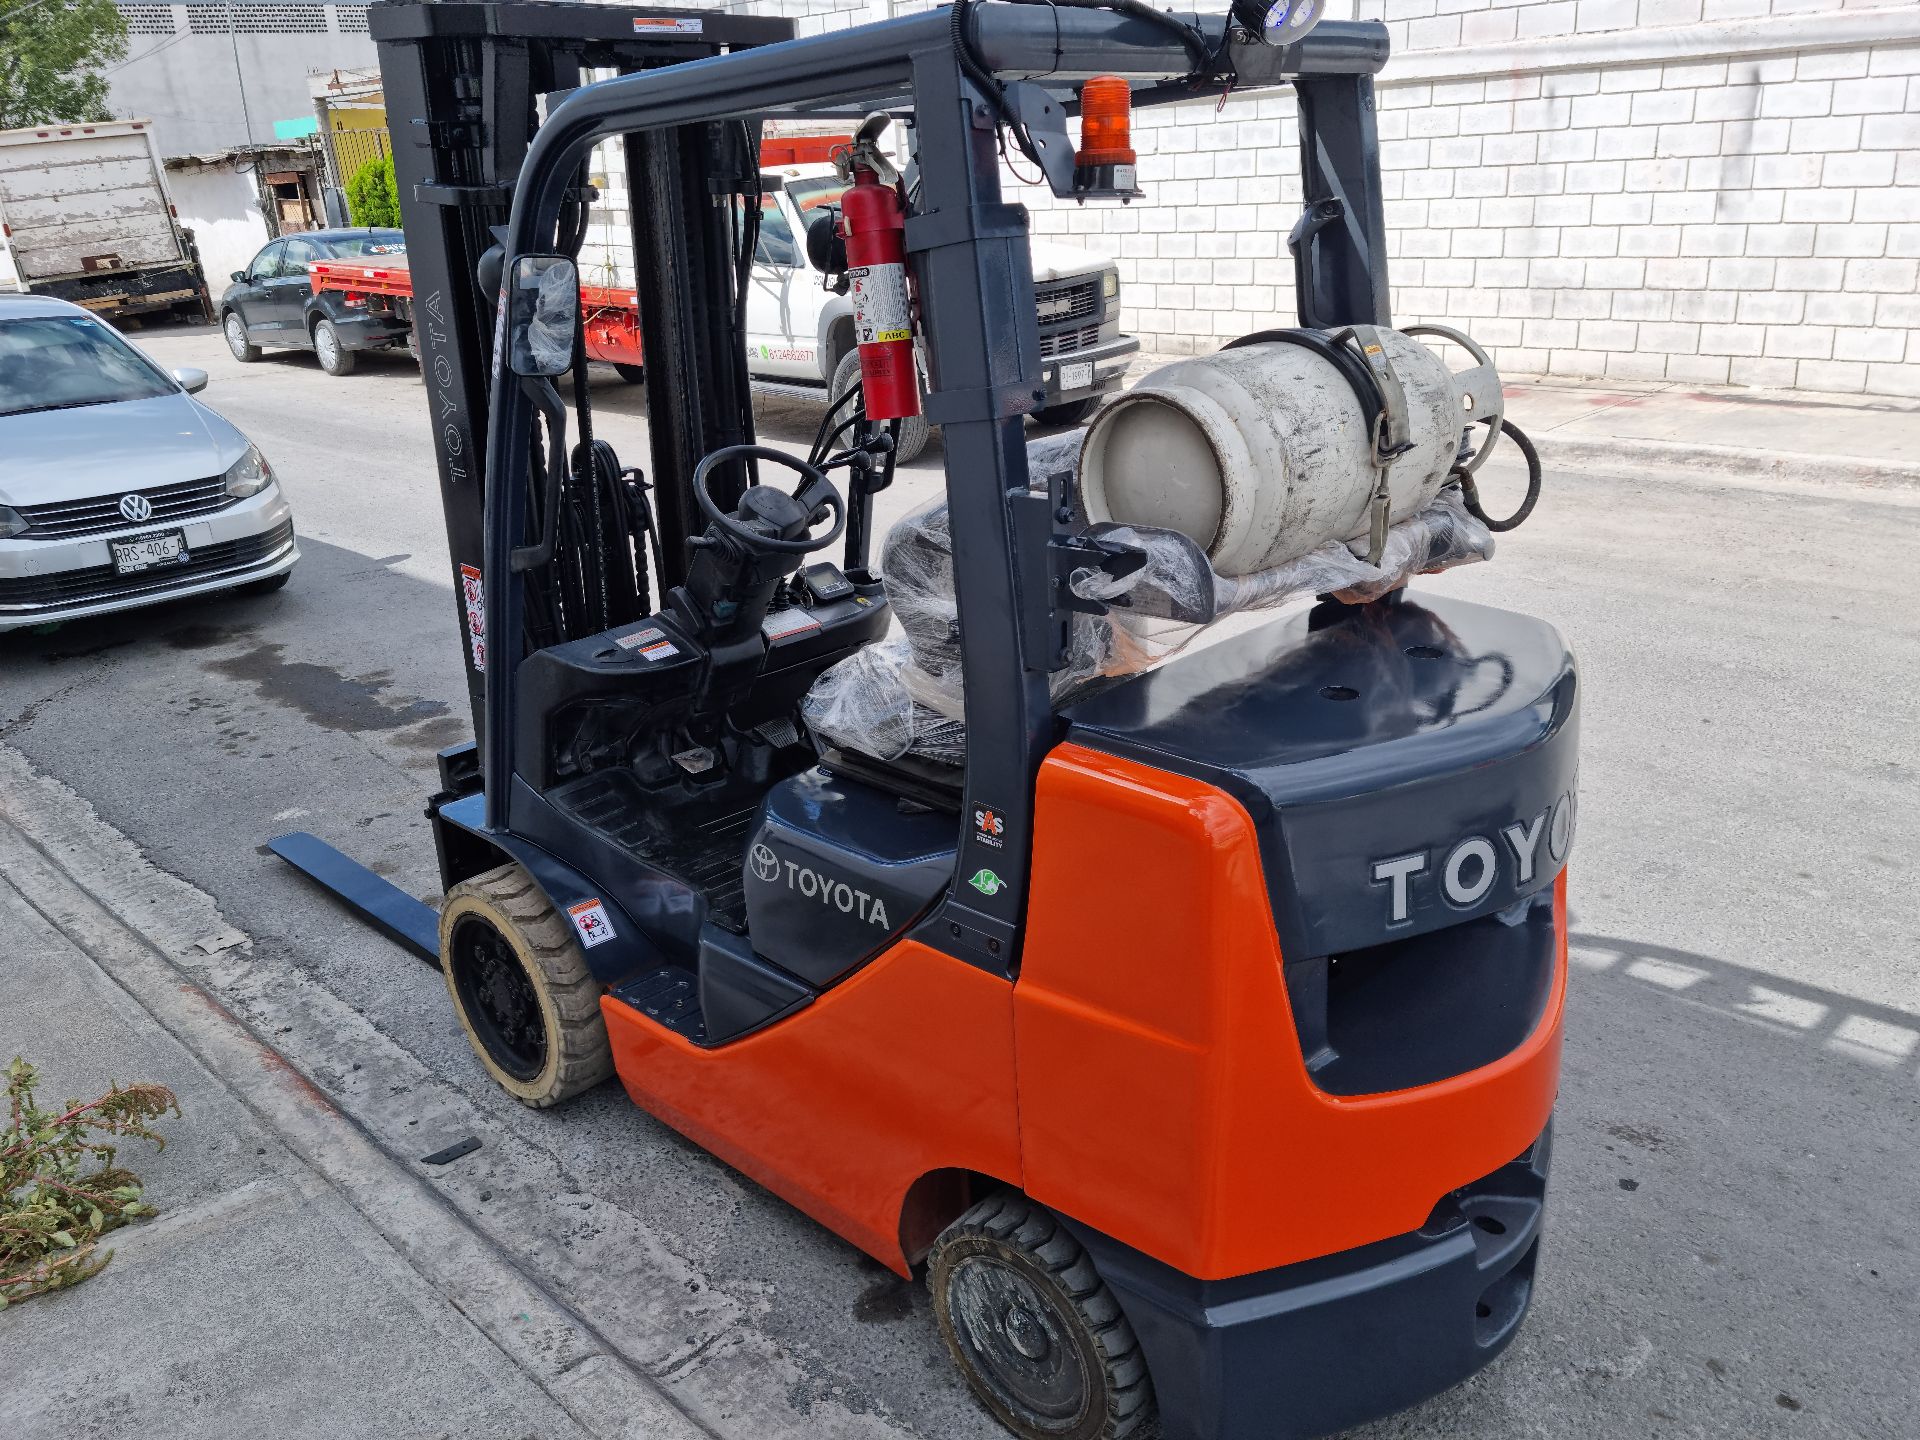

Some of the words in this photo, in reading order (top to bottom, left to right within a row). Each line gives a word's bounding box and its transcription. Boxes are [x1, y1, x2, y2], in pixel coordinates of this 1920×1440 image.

[884, 331, 905, 340] ABC
[425, 290, 468, 483] TOYOTA
[975, 810, 1004, 835] SAS
[784, 859, 890, 931] TOYOTA
